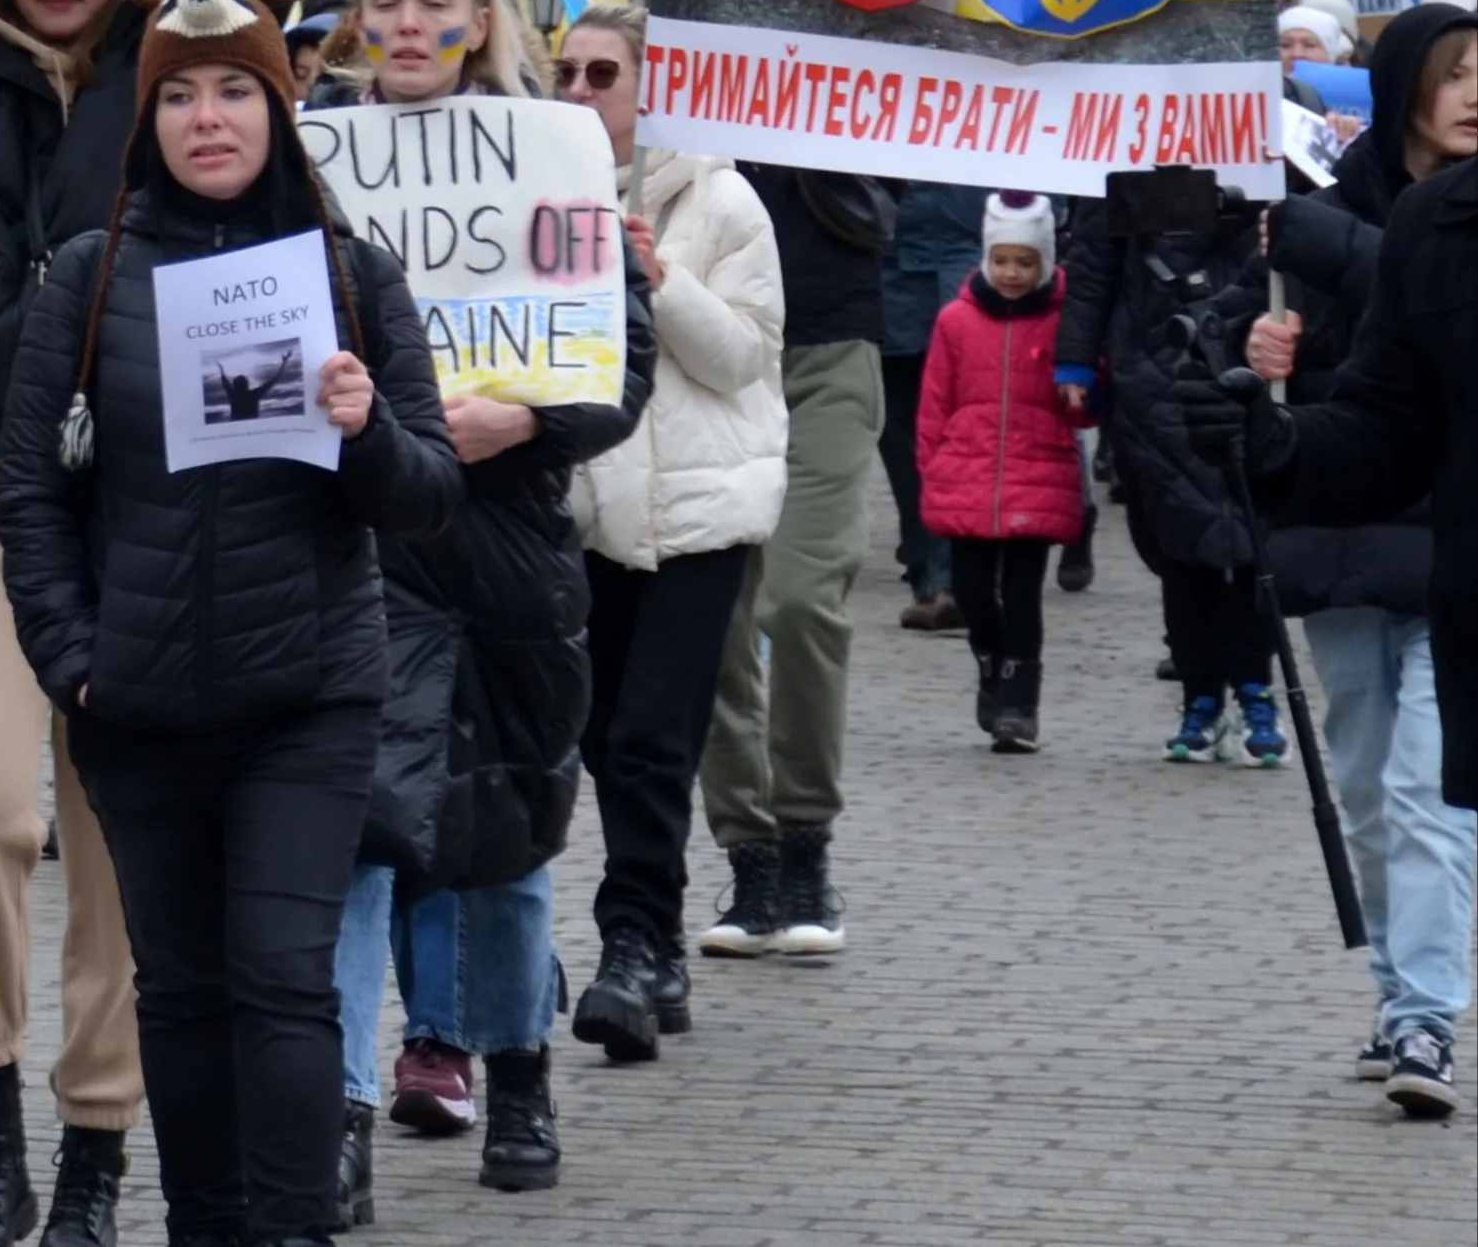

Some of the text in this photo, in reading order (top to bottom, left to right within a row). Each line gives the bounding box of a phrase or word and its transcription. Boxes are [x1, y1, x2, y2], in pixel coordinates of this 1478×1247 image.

[645, 44, 902, 143] ТРИМАЙТЕСЯ
[907, 76, 1040, 156] БРАТИ
[1063, 91, 1124, 160] МИ
[1129, 92, 1148, 165] З
[1157, 91, 1269, 166] ВАМИ!
[367, 204, 617, 275] NDS OFF
[212, 275, 278, 306] NATO
[185, 305, 310, 339] CLOSE THE SKY
